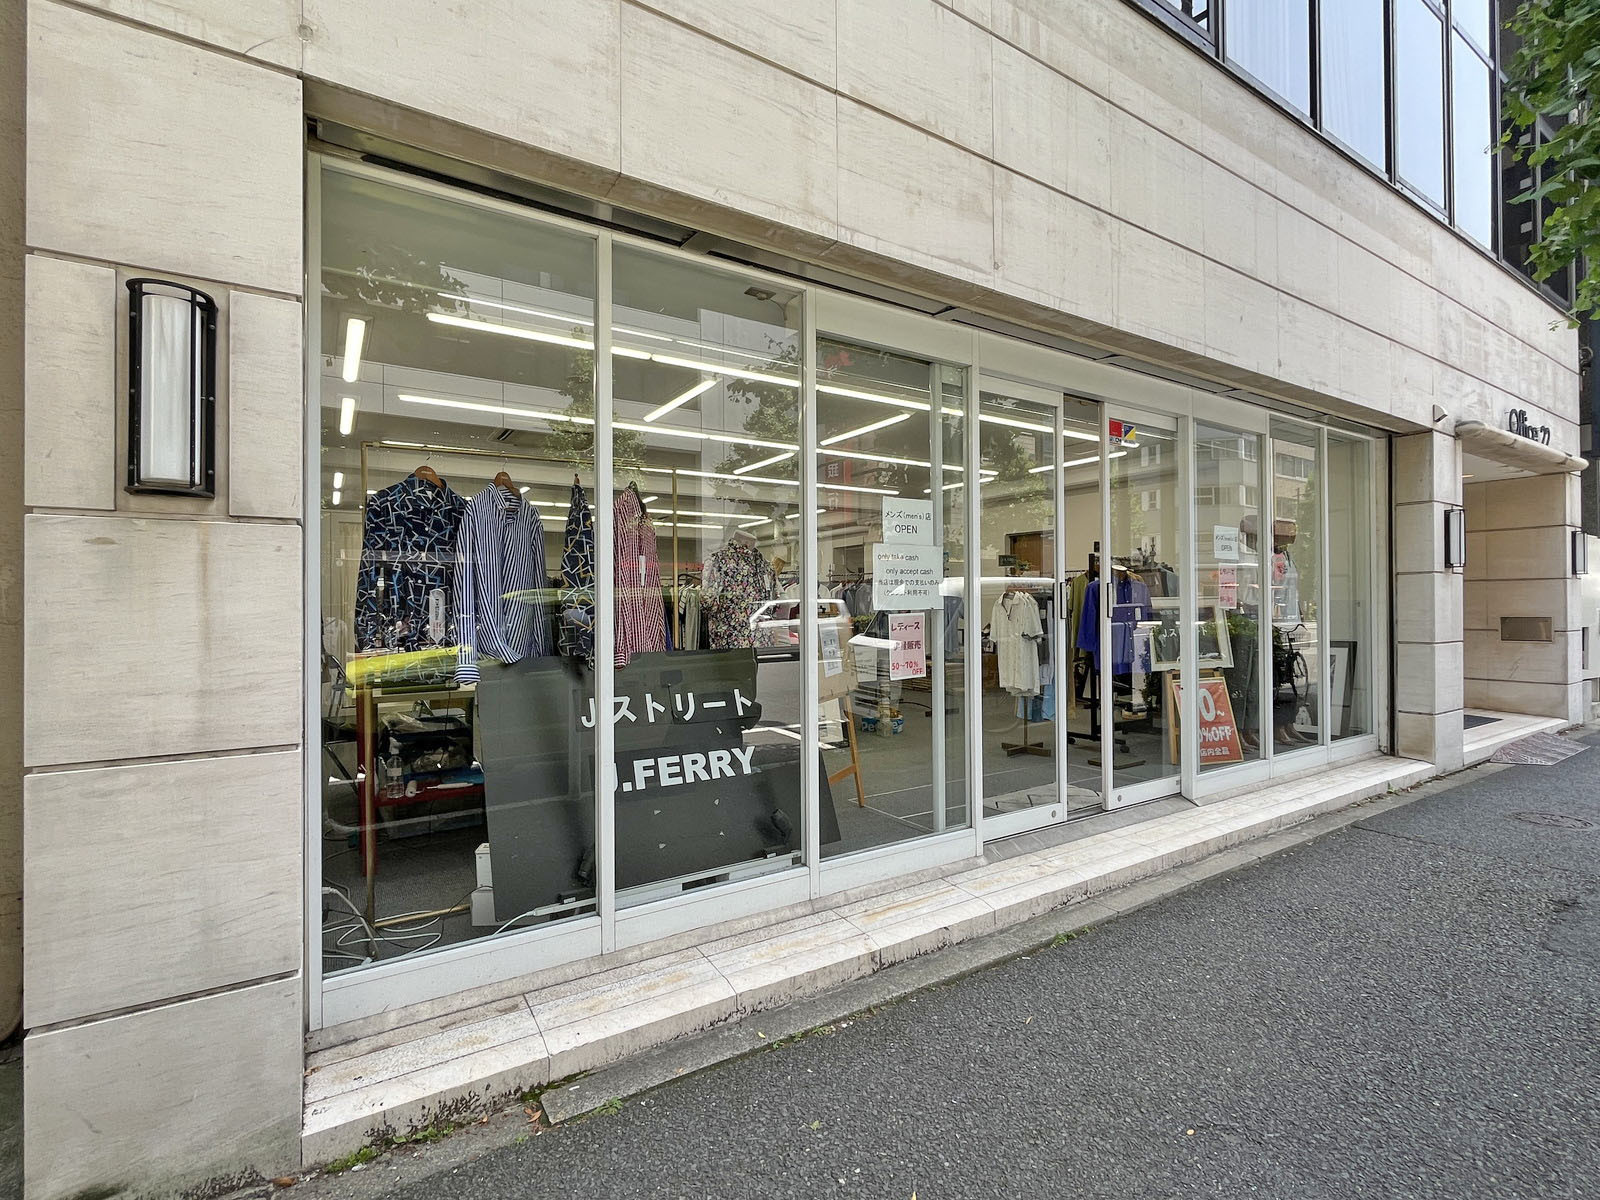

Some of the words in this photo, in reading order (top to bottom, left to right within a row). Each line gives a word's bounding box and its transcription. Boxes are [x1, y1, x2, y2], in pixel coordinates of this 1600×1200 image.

[885, 510, 931, 521] メンズ(men's)店
[894, 524, 918, 534] OPEN
[878, 553, 890, 562] only
[885, 568, 898, 576] only
[891, 621, 921, 632] レディース
[581, 689, 752, 729] Jストリート
[614, 745, 757, 793] .FERRY
